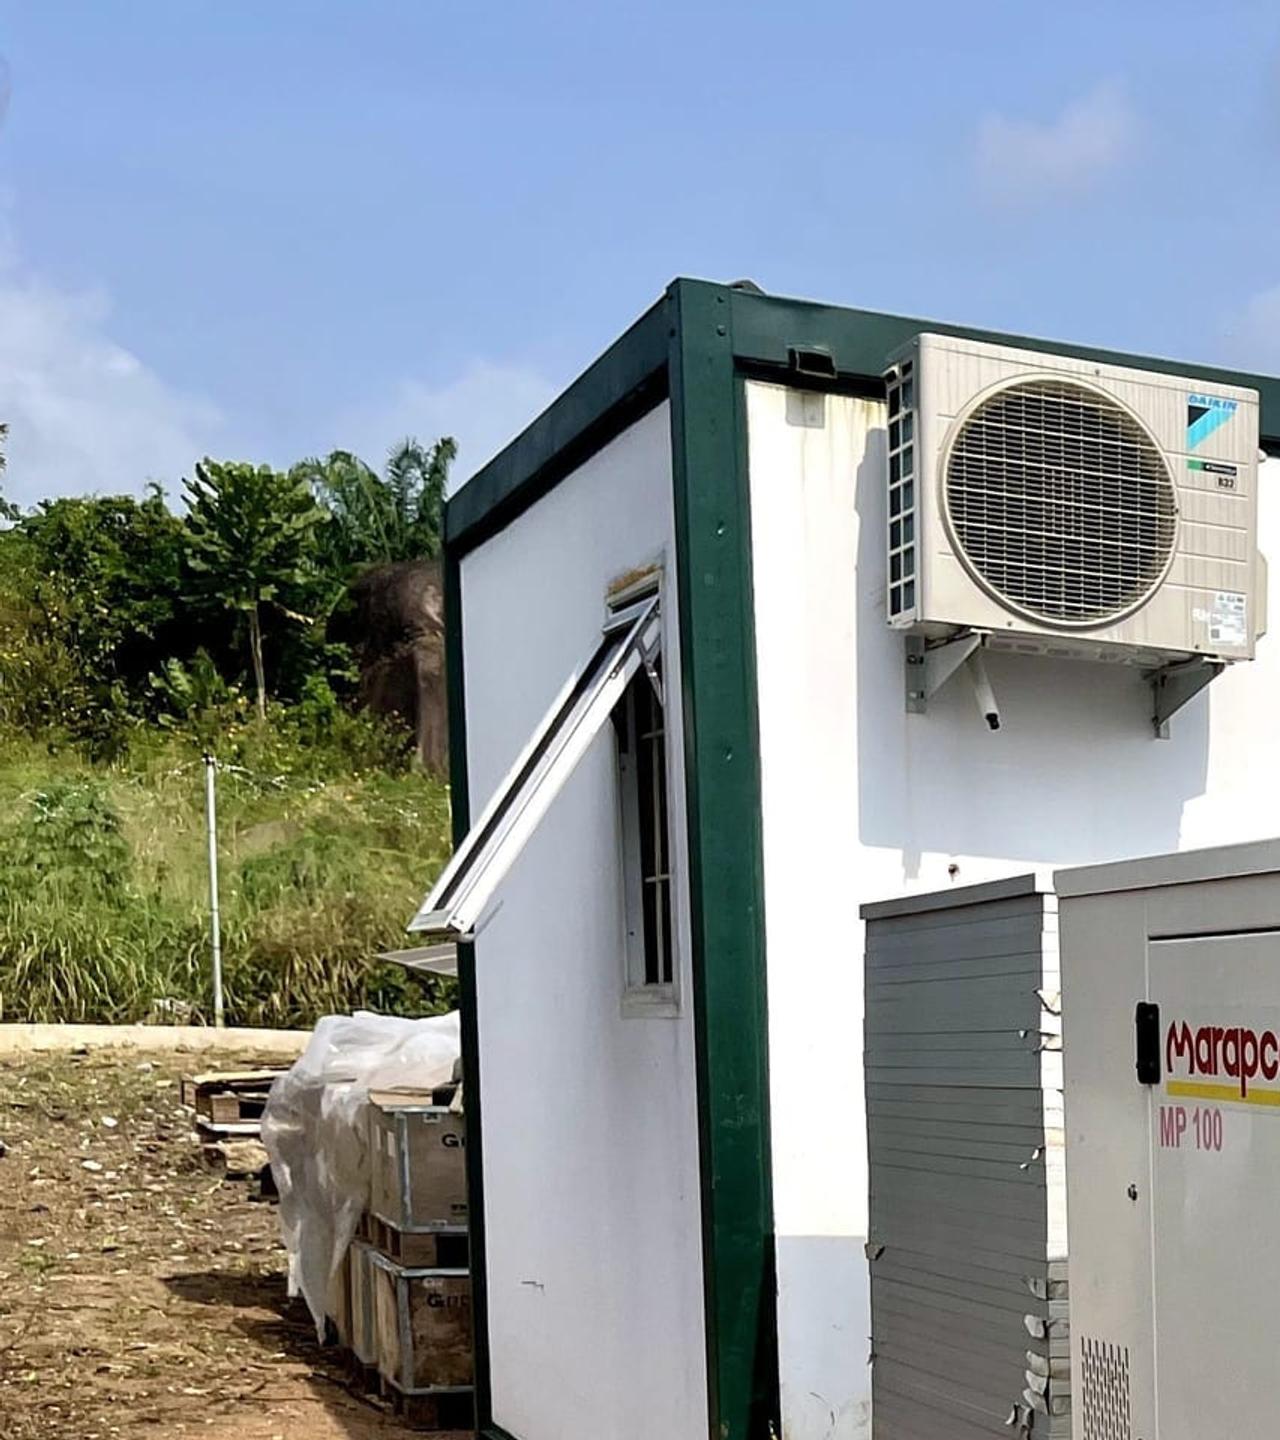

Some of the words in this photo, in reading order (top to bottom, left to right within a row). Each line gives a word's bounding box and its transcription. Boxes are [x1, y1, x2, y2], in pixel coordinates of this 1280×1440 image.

[1189, 395, 1238, 411] DAIKIN
[1160, 1106, 1187, 1148] MP
[1192, 1106, 1223, 1151] 100
